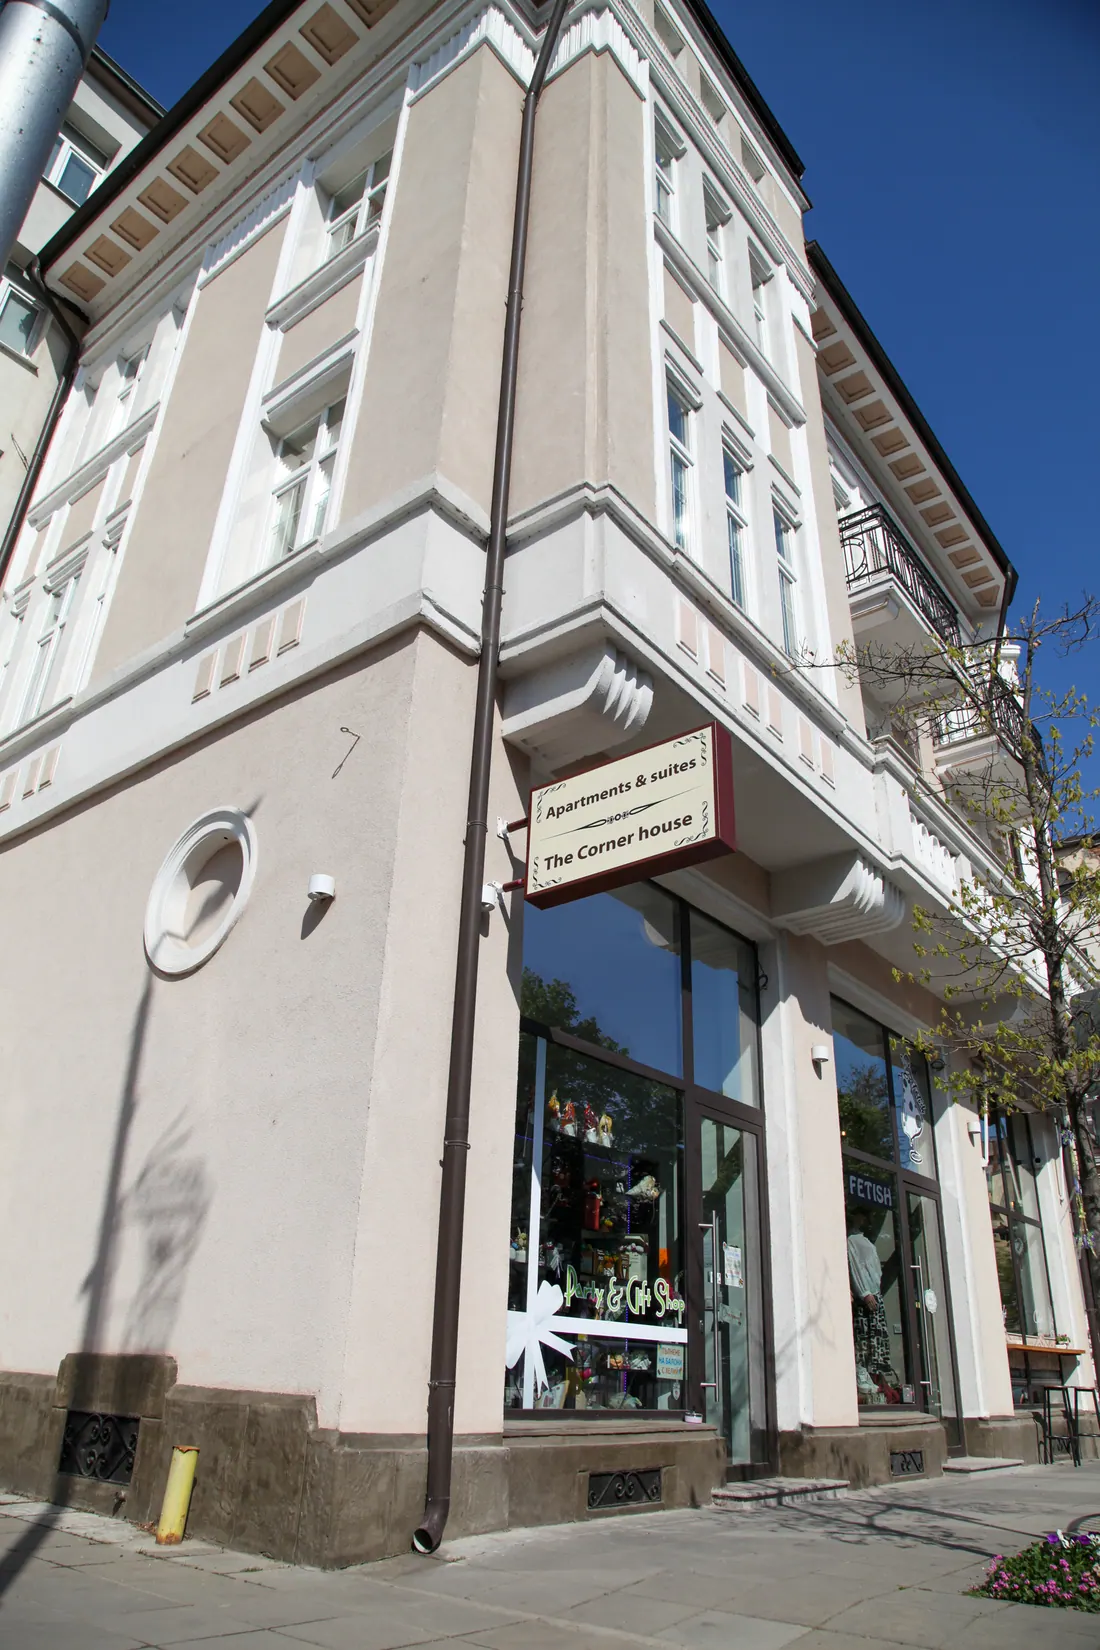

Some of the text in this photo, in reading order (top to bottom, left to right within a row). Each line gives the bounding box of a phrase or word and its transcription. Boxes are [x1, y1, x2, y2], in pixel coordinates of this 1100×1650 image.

[545, 757, 697, 819] Apartments & suites
[544, 813, 693, 871] The Corner house
[849, 1174, 893, 1207] FETISH
[564, 1264, 685, 1324] Party & Gift Shop
